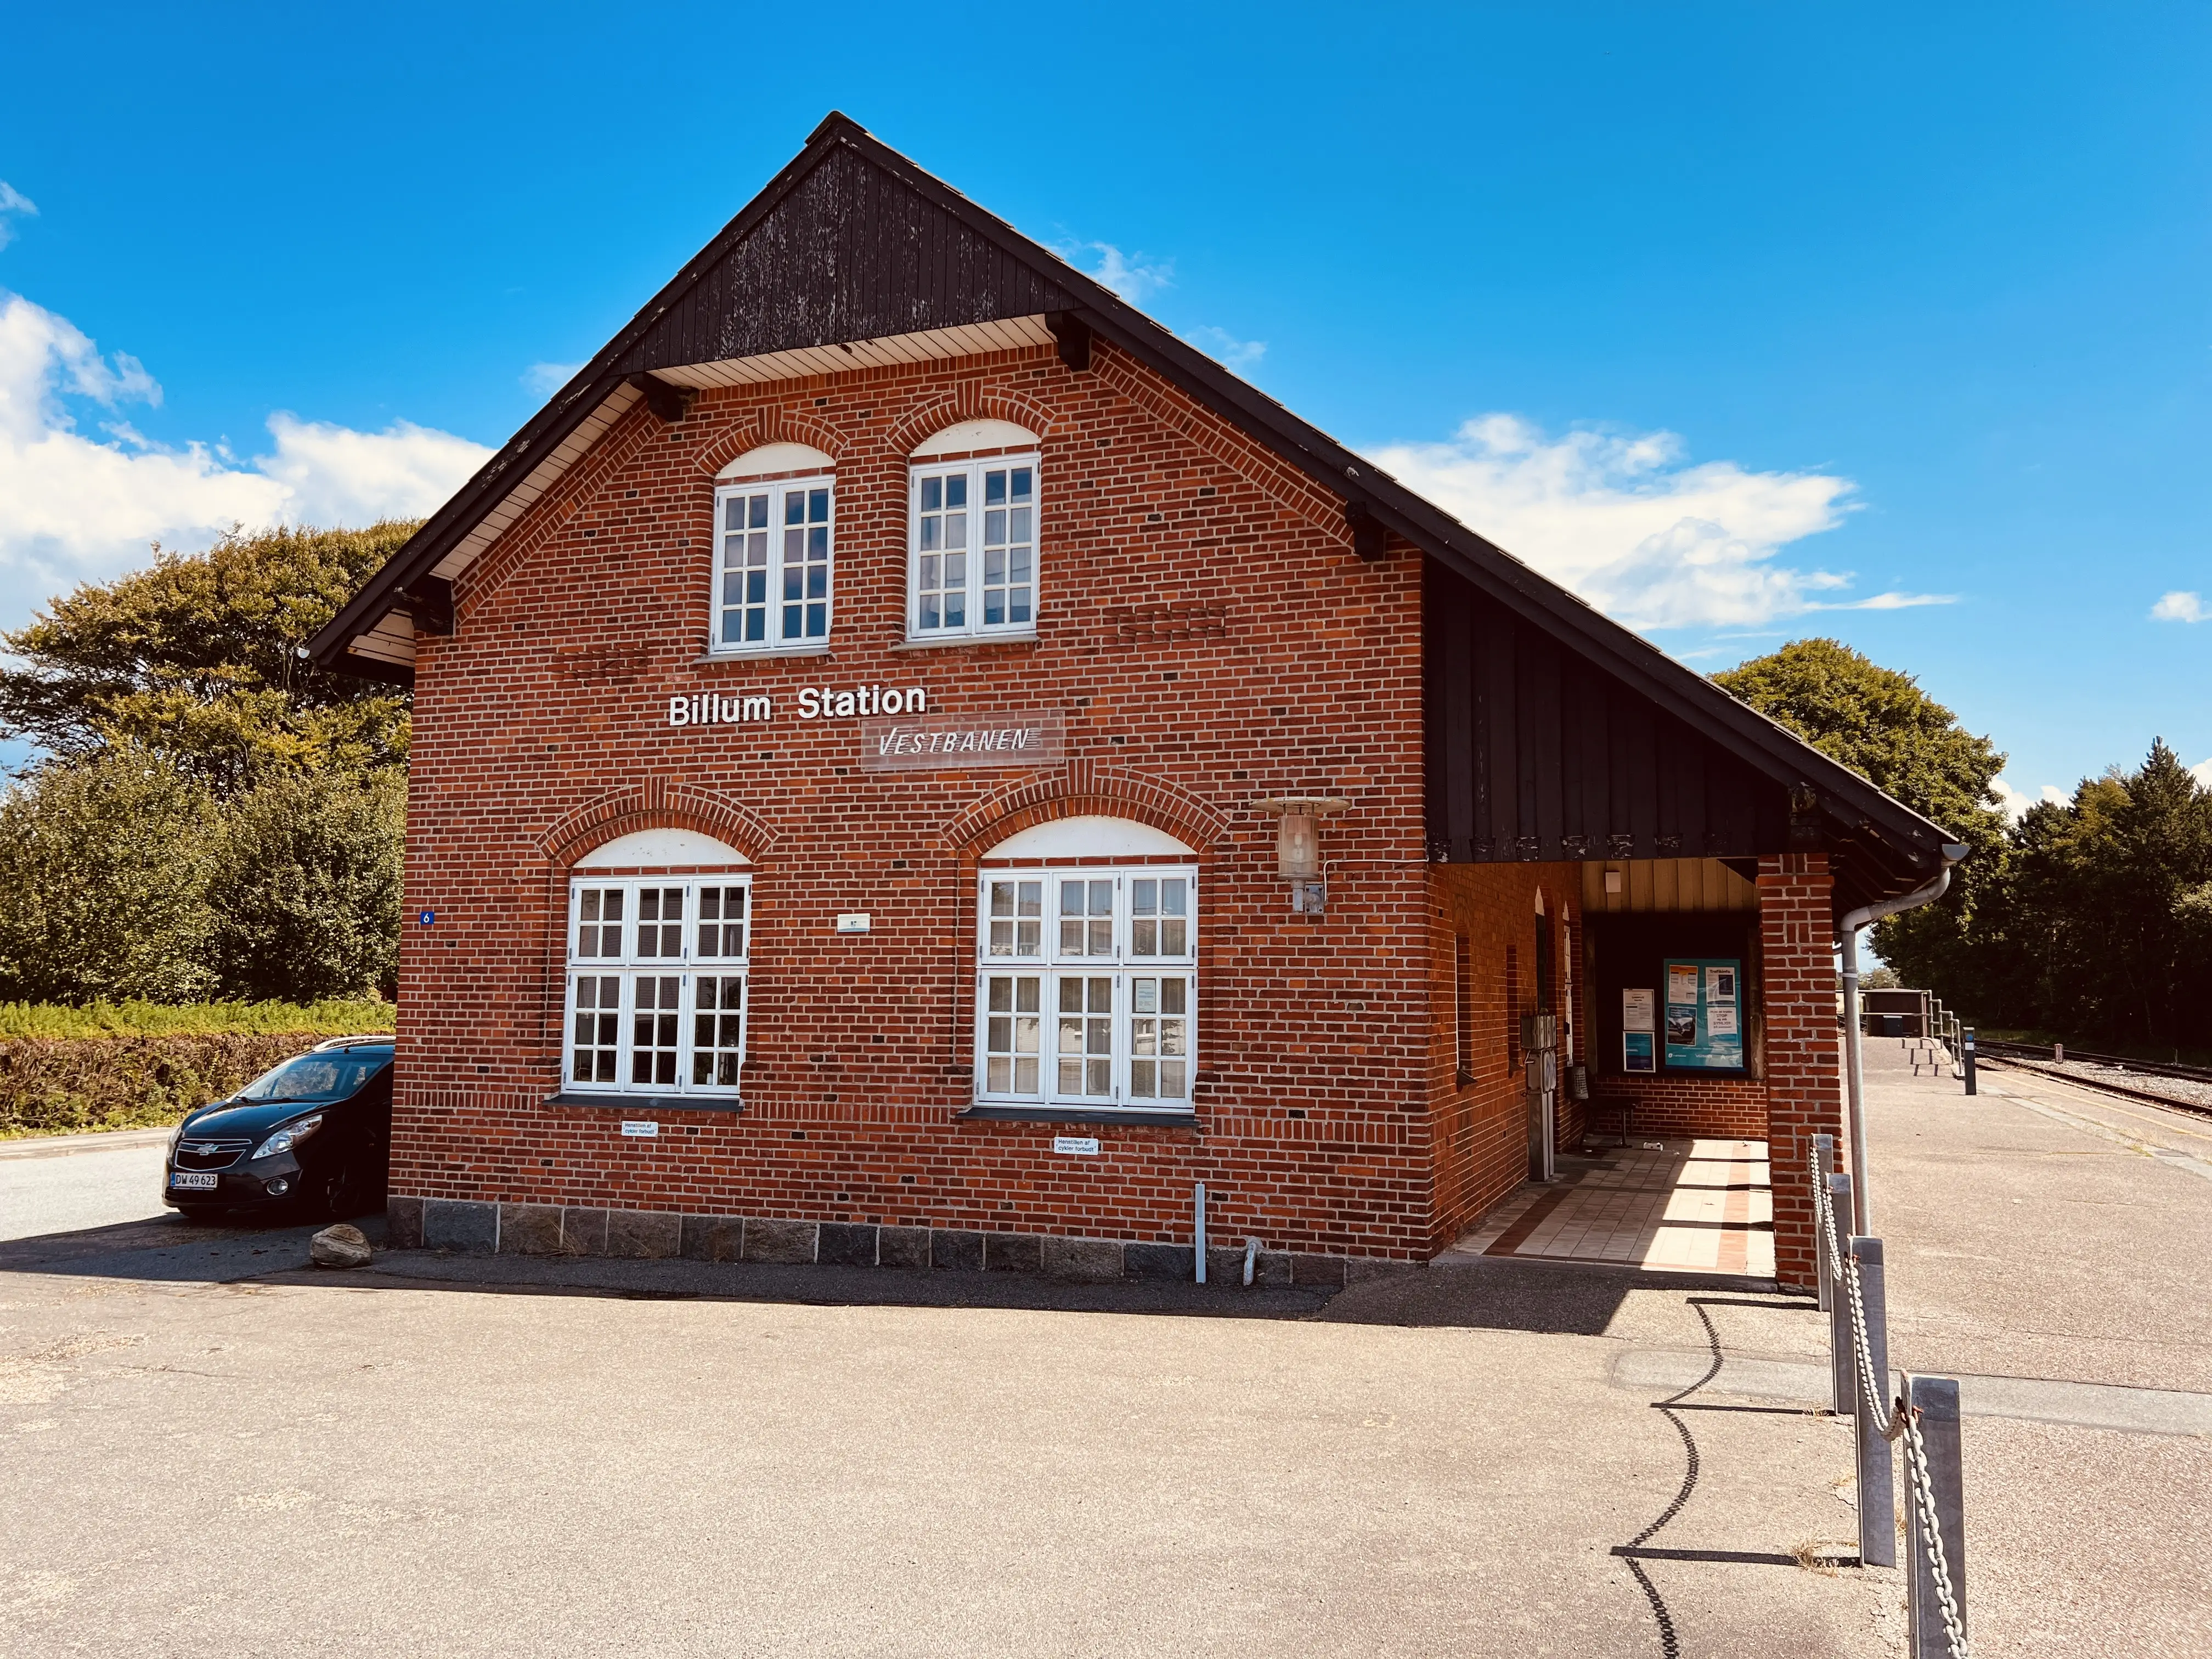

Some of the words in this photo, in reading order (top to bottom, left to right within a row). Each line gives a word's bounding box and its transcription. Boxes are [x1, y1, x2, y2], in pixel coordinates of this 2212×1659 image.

[669, 693, 771, 726] Billum
[798, 684, 926, 719] Station
[880, 726, 1031, 755] VESTBANEN
[423, 913, 430, 923] 6
[176, 1175, 188, 1184] DW
[189, 1175, 199, 1185] 49
[201, 1176, 216, 1186] 623
